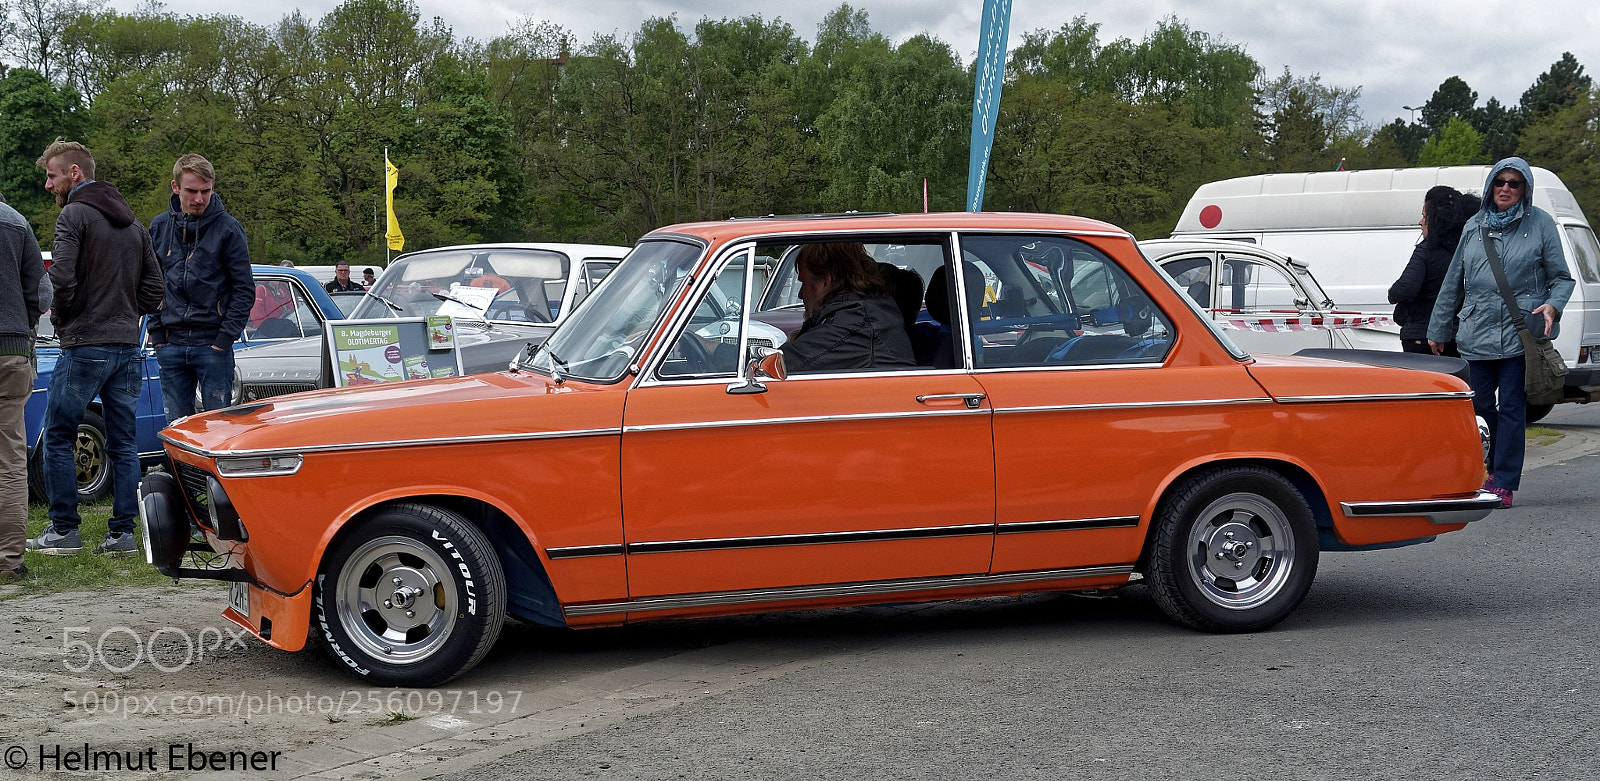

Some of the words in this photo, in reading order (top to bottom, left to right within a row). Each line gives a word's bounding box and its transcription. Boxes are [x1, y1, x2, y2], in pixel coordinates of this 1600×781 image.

[976, 0, 999, 115] Magdeb
[347, 337, 388, 346] OLDTIMERTAG
[350, 329, 392, 338] Magdeburger
[431, 529, 477, 616] VITOUR
[315, 573, 371, 676] FORMULA
